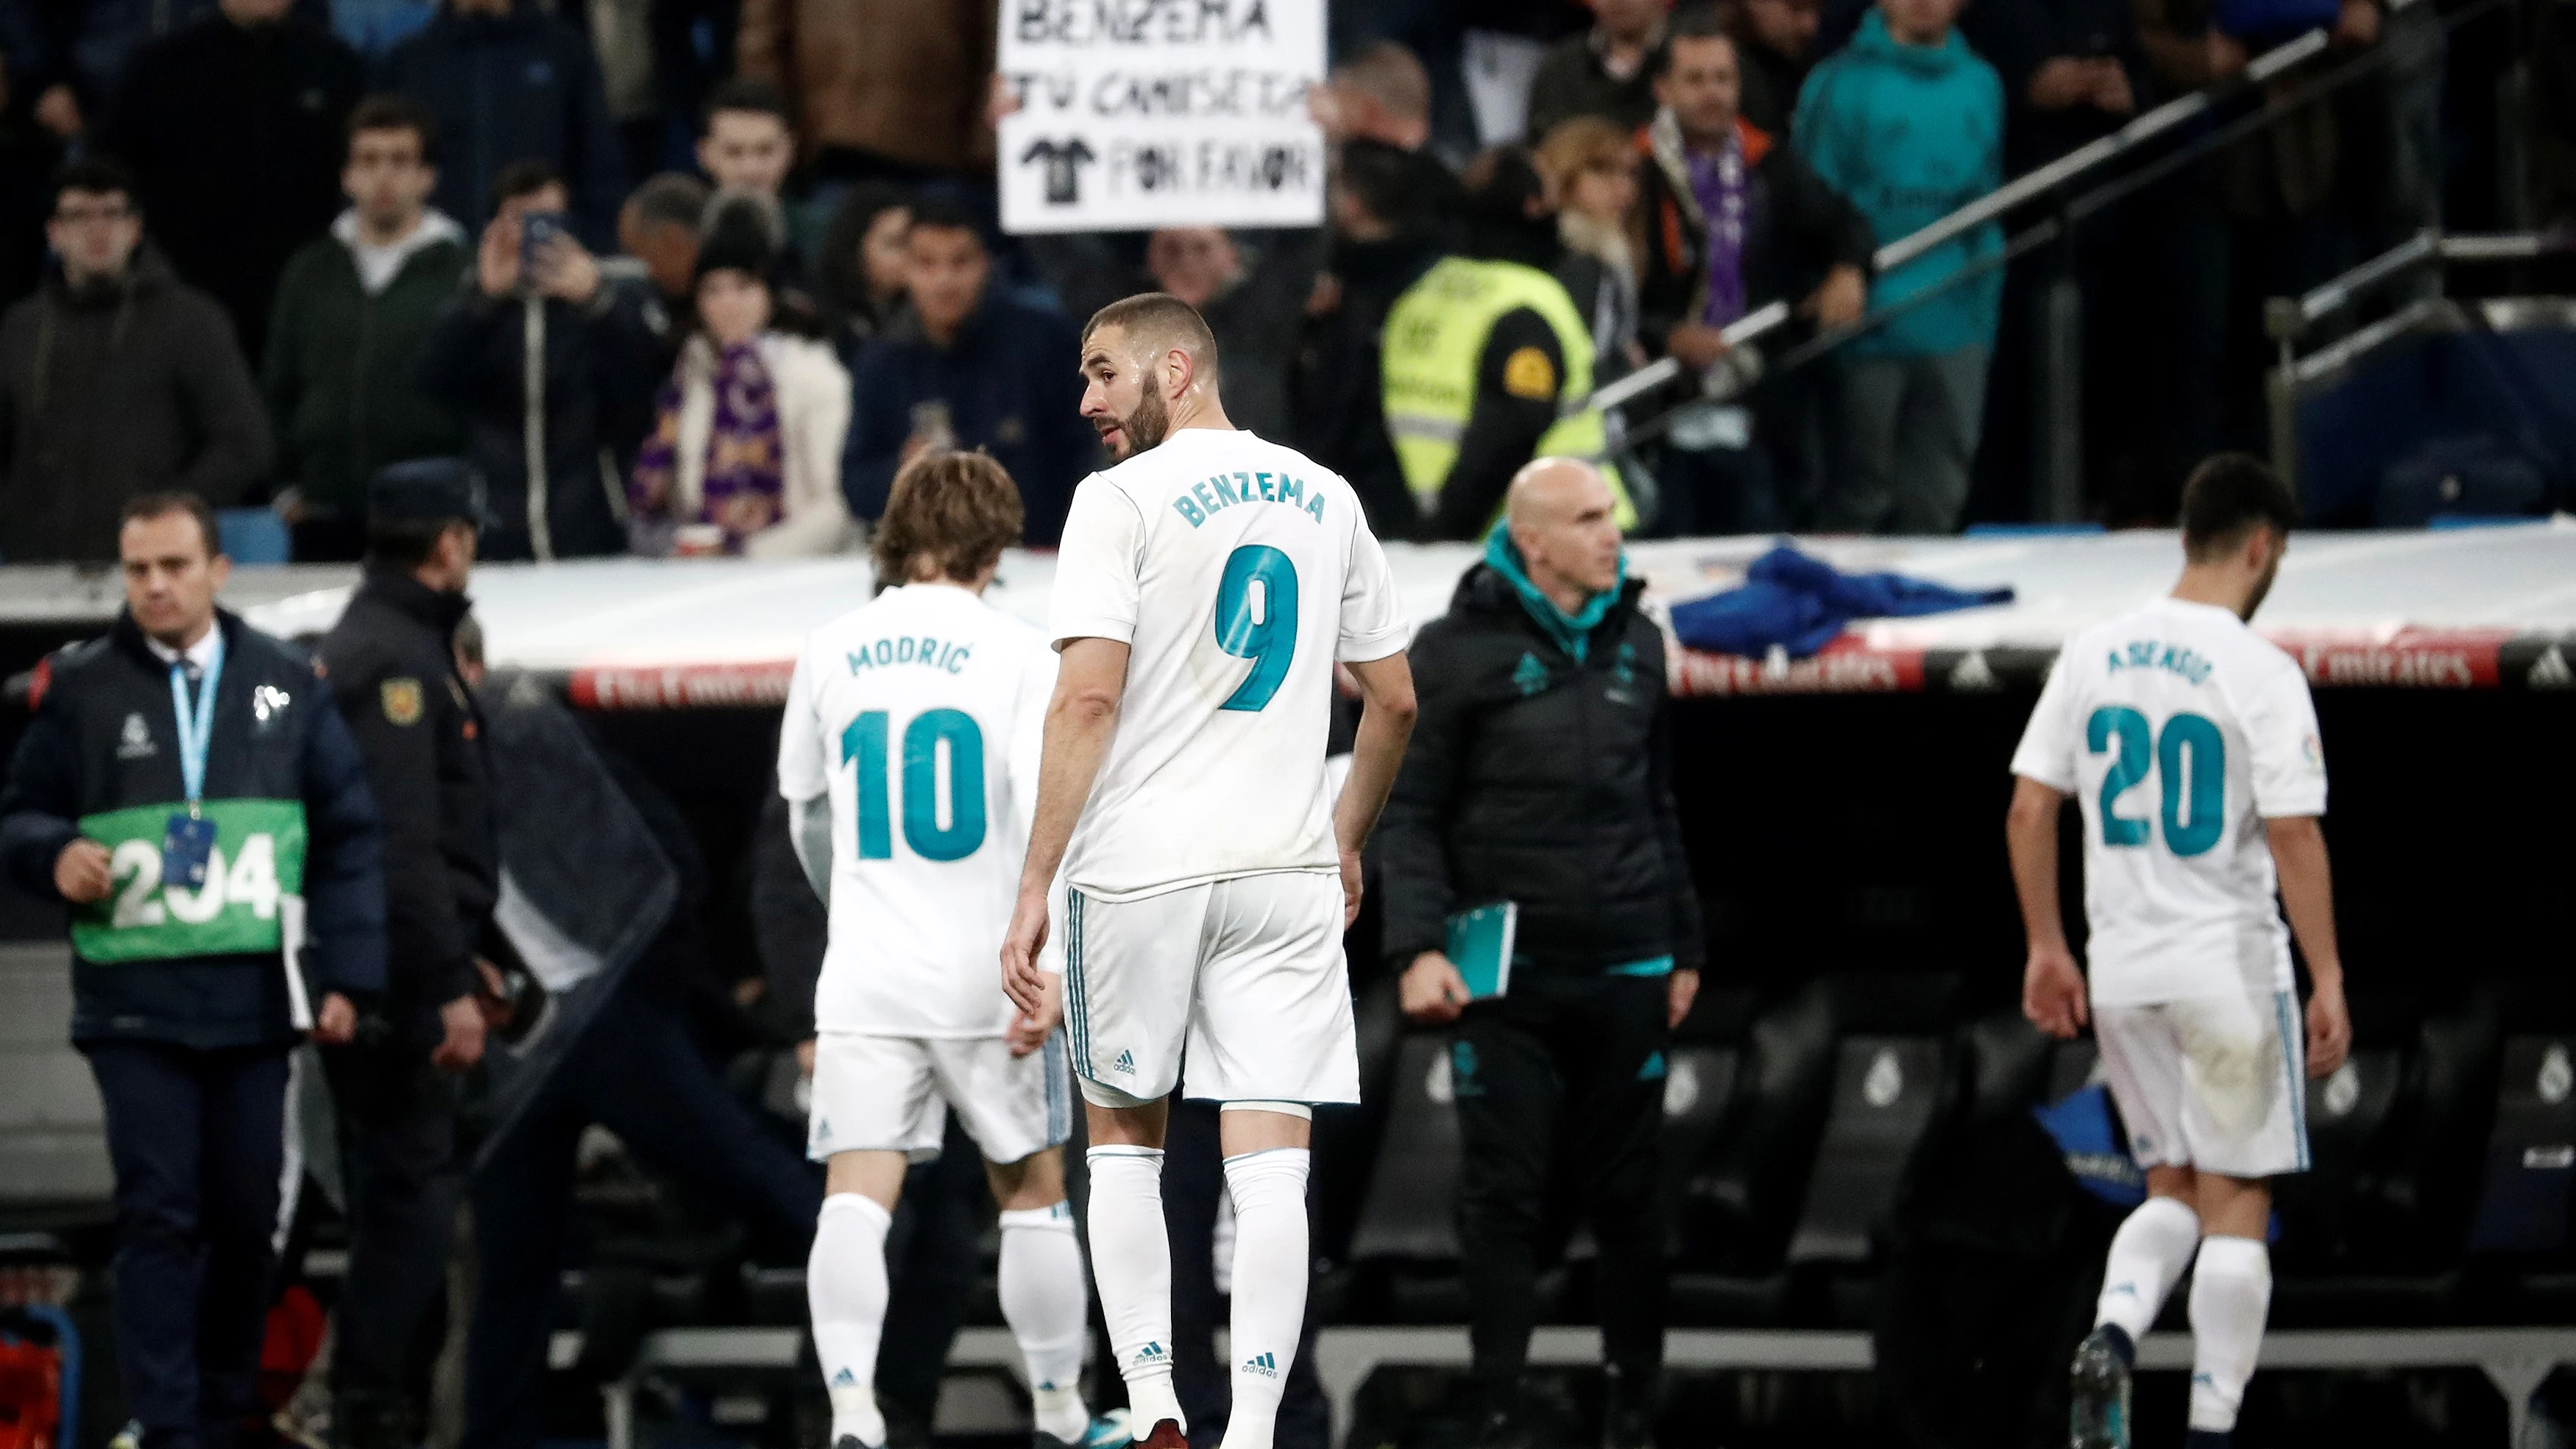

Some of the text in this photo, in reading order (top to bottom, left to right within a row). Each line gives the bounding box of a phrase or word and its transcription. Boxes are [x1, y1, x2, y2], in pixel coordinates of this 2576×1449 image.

[1016, 0, 1273, 44] BENZEMA
[1173, 472, 1326, 529] BENZEMA
[846, 636, 974, 676] MODRIĆ
[1215, 545, 1298, 712] 9
[841, 709, 987, 862] 10
[2087, 706, 2224, 857] 20
[110, 833, 280, 929] 204
[1133, 1354, 1167, 1367] adidas
[1242, 1364, 1278, 1379] adidas
